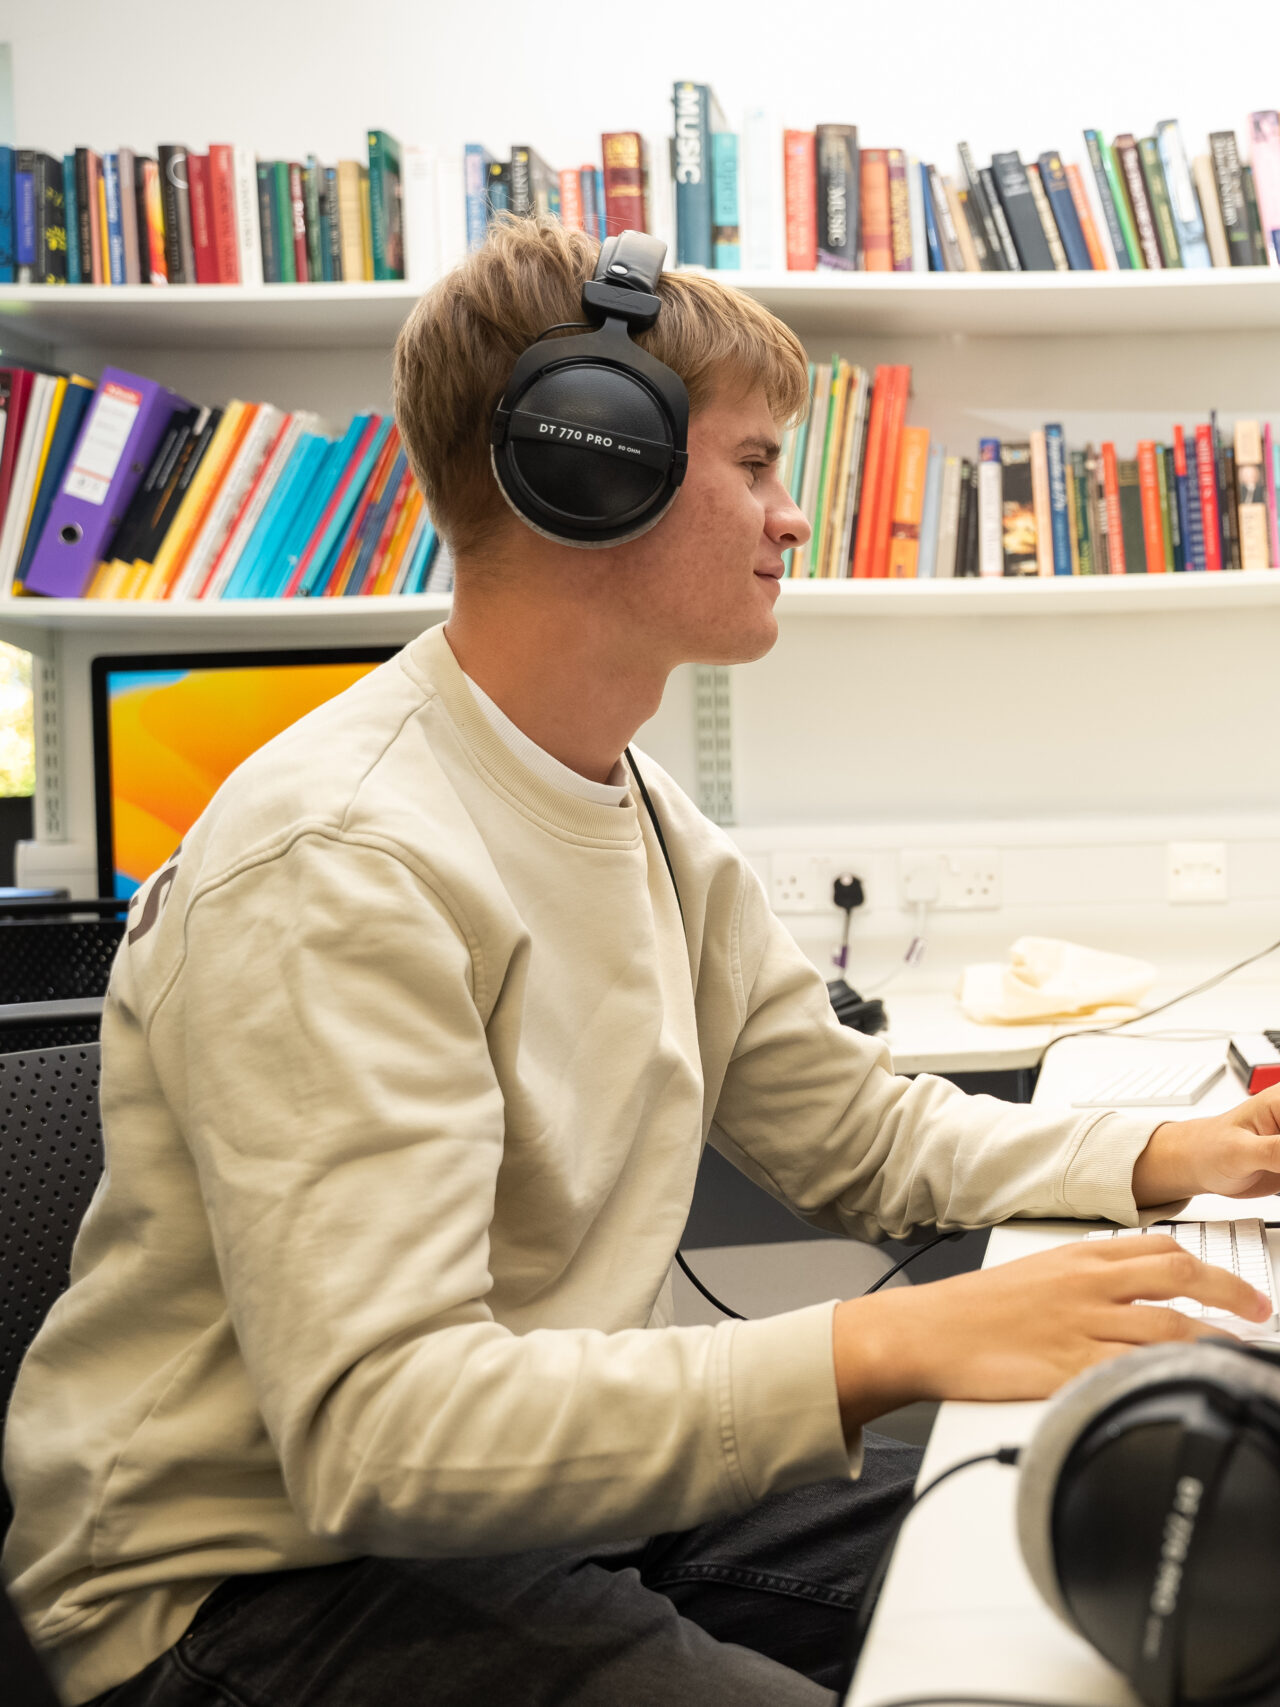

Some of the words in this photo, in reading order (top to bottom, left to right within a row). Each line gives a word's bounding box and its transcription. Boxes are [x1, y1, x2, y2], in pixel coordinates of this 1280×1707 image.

[675, 86, 701, 185] MUSIC
[826, 184, 847, 247] MUSIC
[539, 423, 557, 434] DT
[558, 427, 582, 440] 770
[586, 433, 613, 447] PRO
